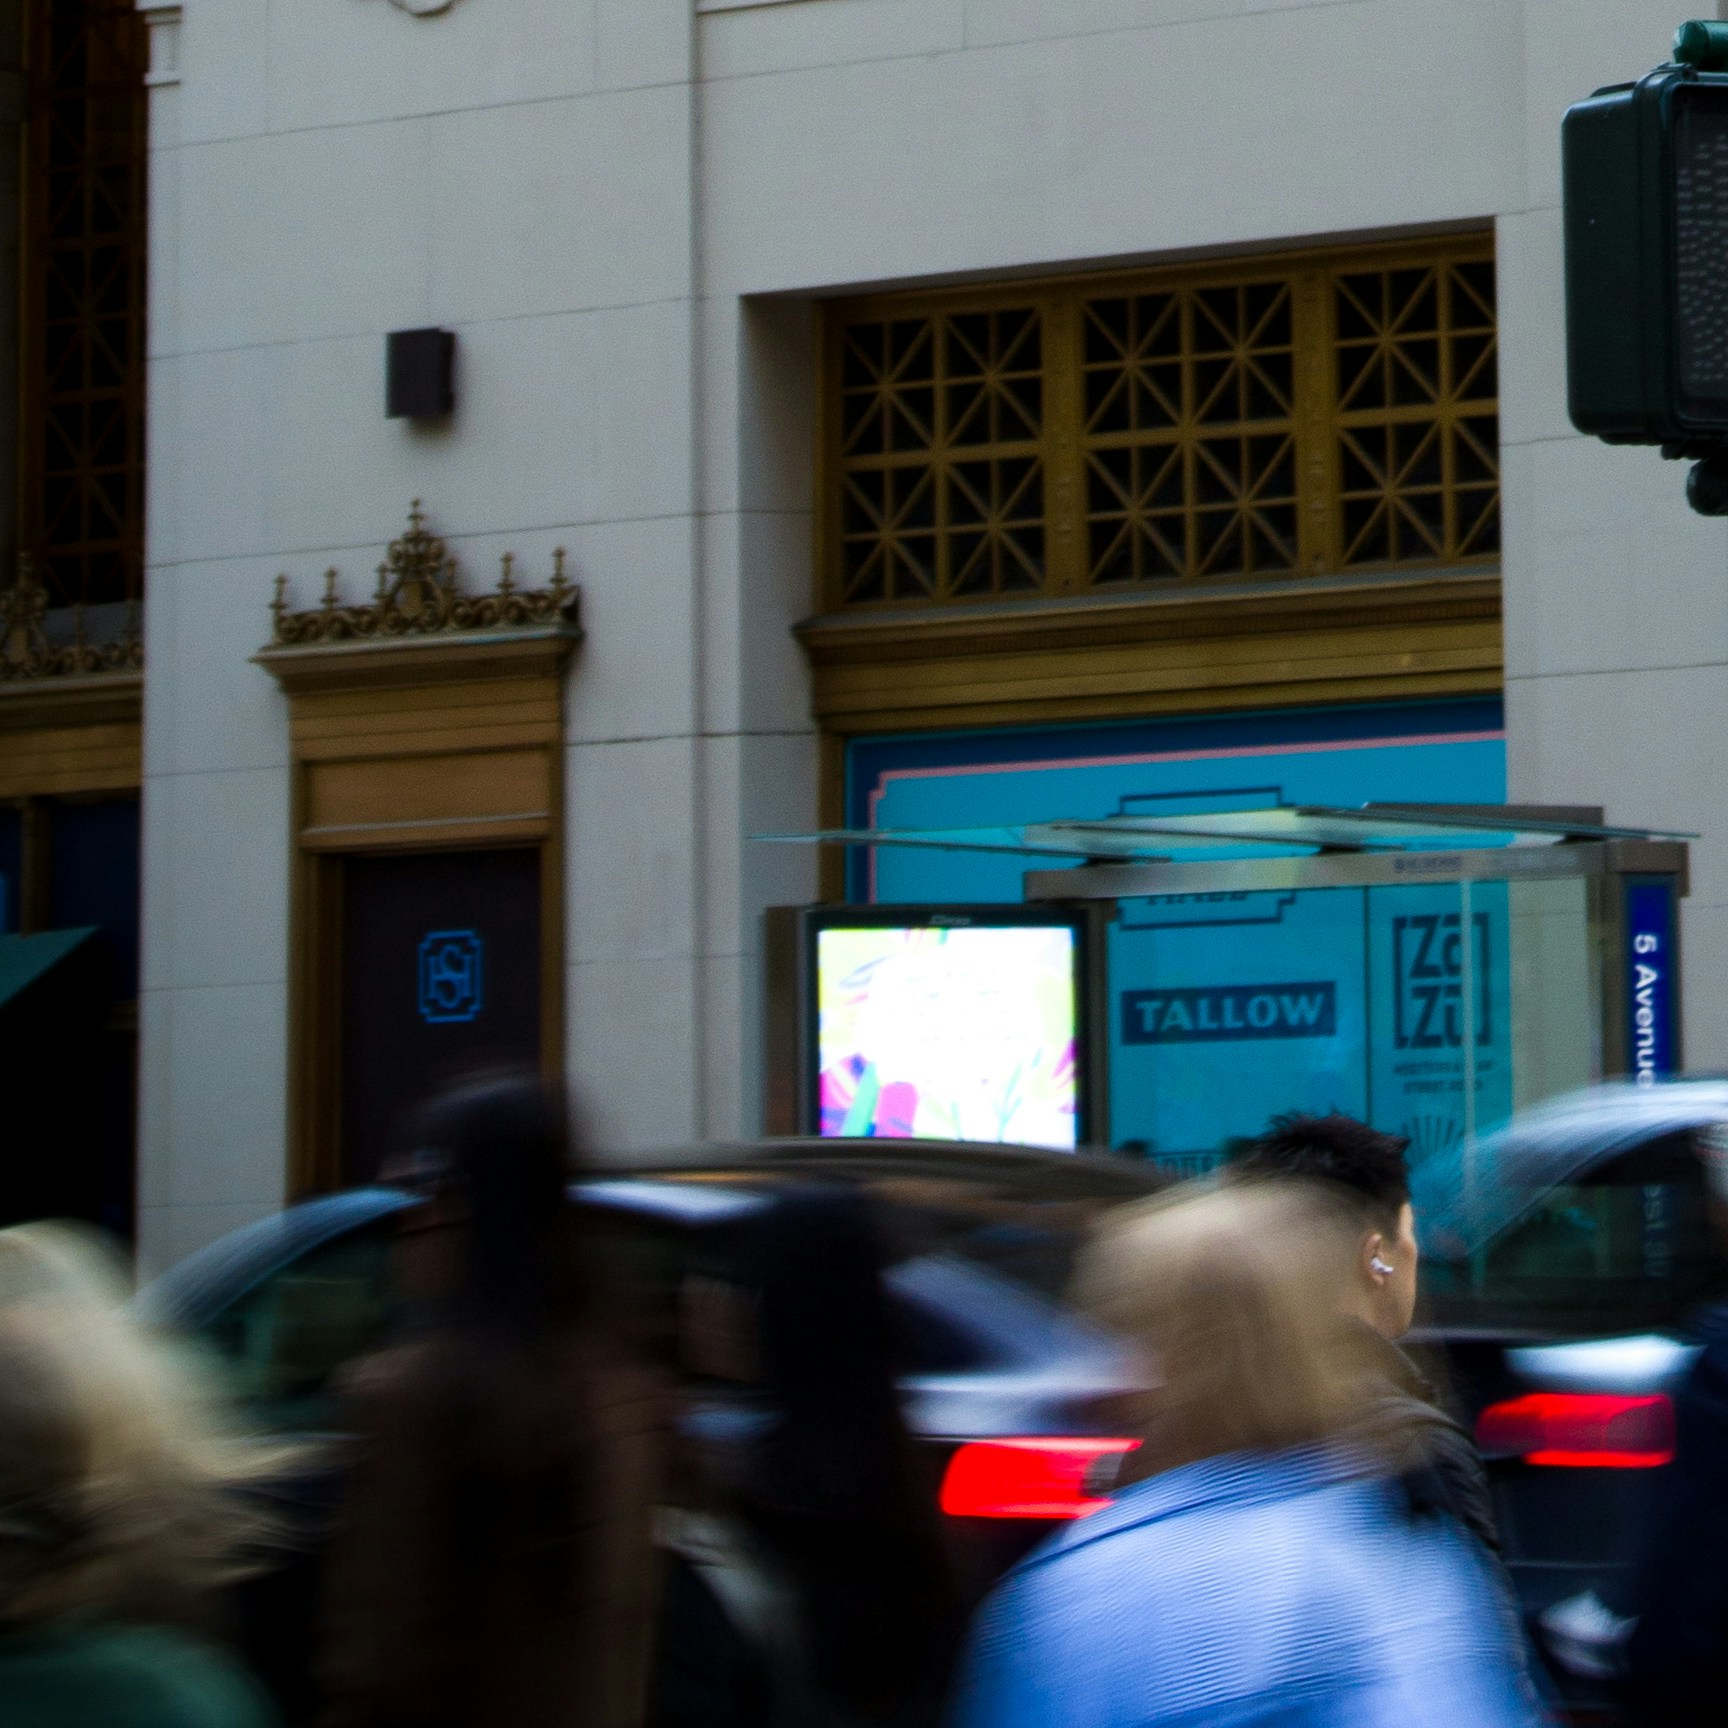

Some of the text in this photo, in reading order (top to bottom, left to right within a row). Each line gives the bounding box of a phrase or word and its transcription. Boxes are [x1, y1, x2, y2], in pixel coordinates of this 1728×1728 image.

[1134, 992, 1326, 1034] TALLOW
[1633, 934, 1659, 1089] 5 Avenue
